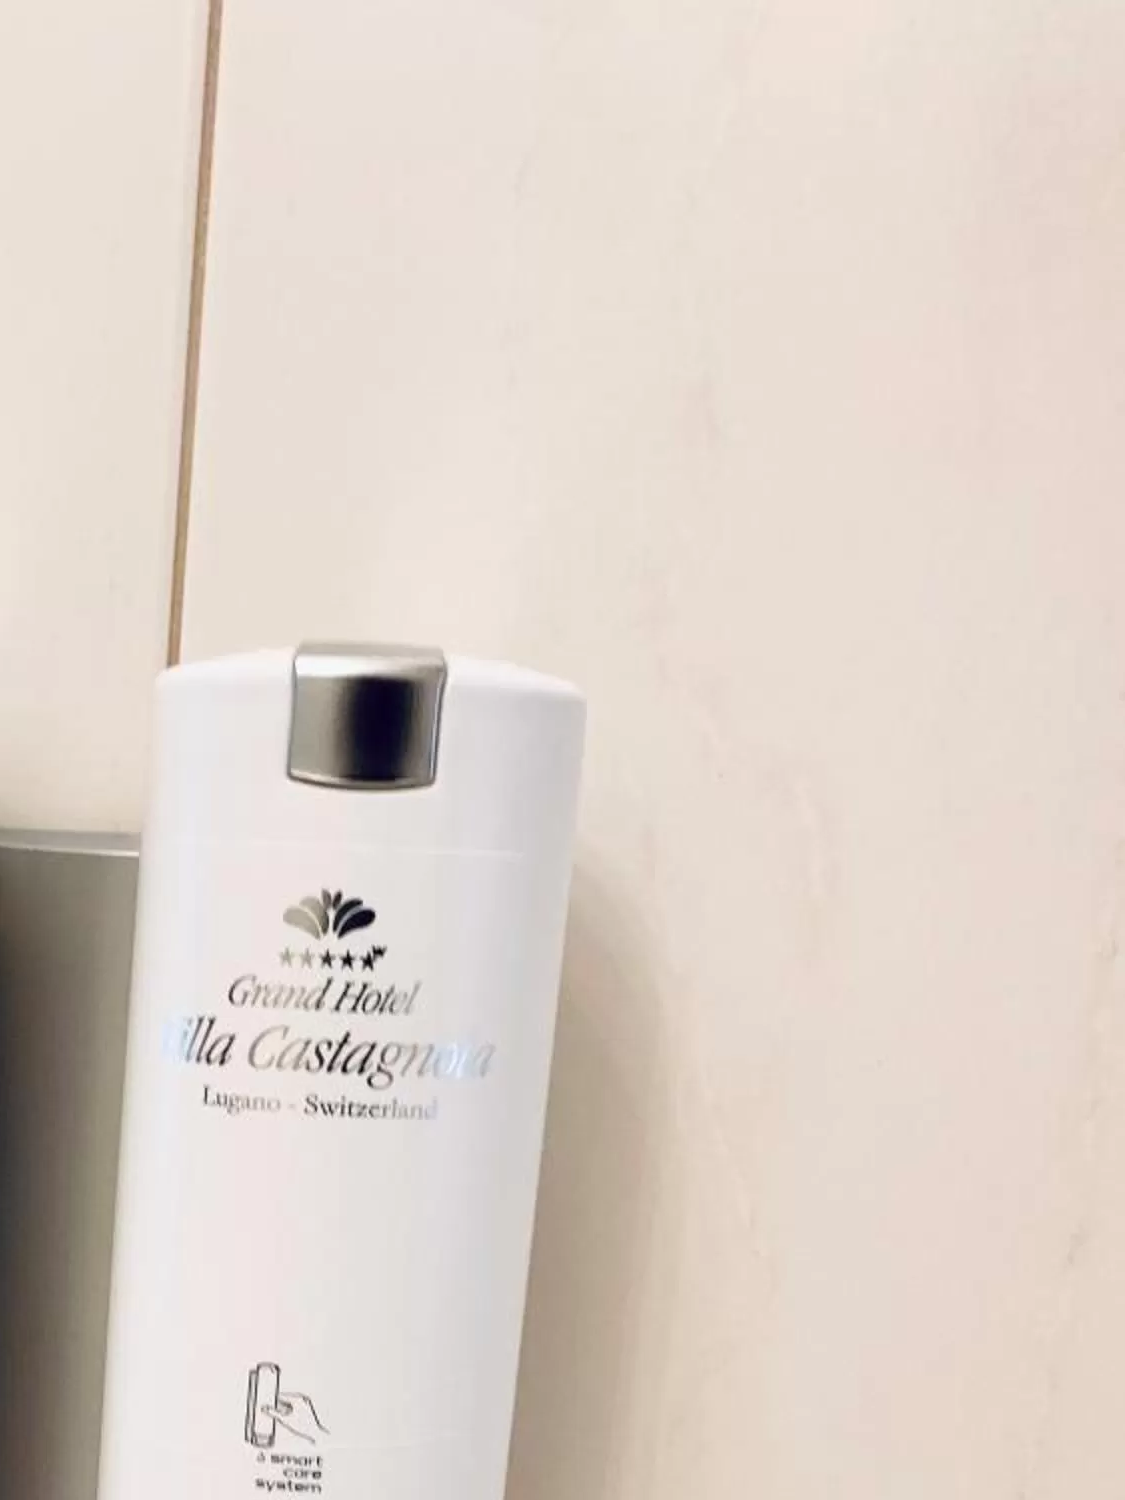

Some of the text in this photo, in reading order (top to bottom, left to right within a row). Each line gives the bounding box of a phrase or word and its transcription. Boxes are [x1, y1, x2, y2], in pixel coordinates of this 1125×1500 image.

[228, 974, 422, 1016] Grand Hotel
[165, 1015, 236, 1067] illa
[202, 1084, 282, 1116] Lugano
[303, 1093, 438, 1121] Switzerland
[270, 1454, 324, 1468] smart
[282, 1467, 322, 1480] care
[255, 1478, 322, 1495] system
